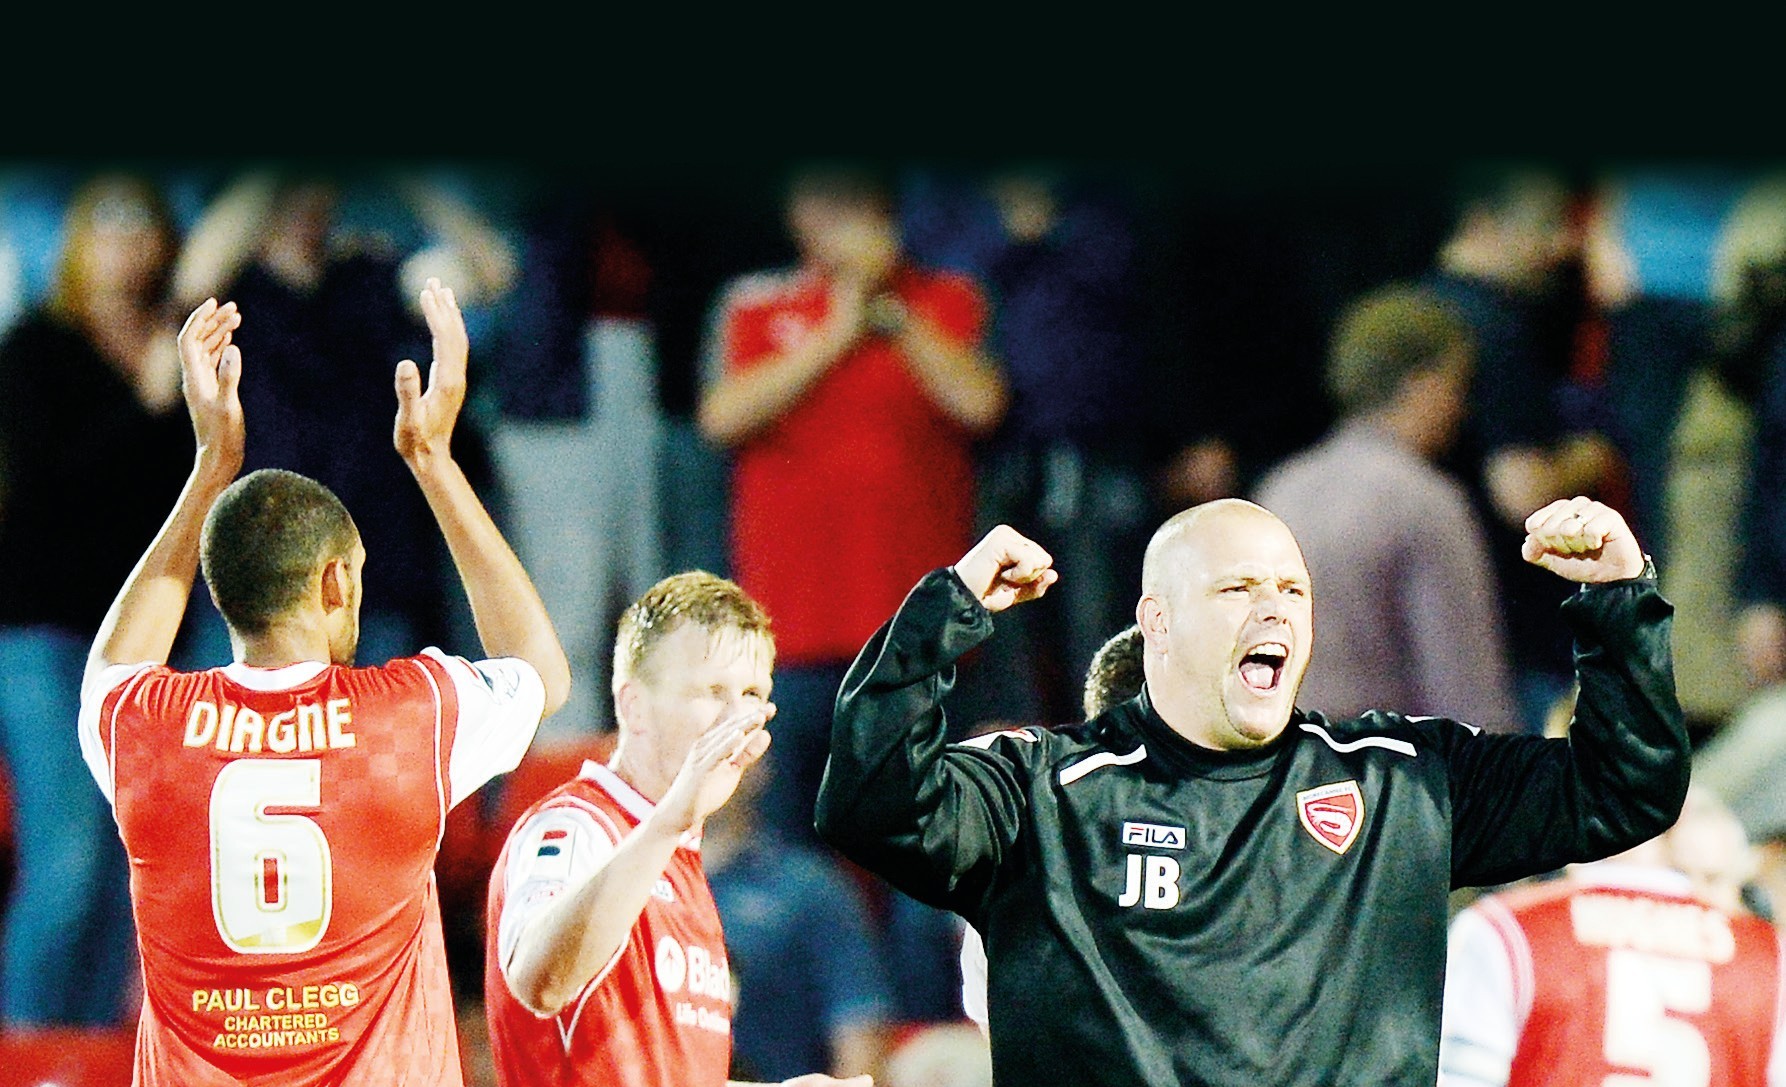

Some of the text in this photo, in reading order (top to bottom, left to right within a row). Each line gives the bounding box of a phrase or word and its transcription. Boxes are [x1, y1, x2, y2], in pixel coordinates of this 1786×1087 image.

[183, 698, 356, 753] DIAGNE
[1129, 827, 1179, 845] FILA
[209, 759, 333, 954] 6
[1119, 854, 1181, 910] JB
[192, 983, 360, 1012] PAUL CLEGG
[224, 1013, 328, 1032] CHARTERED
[213, 1028, 340, 1048] ACCOUNTANTS
